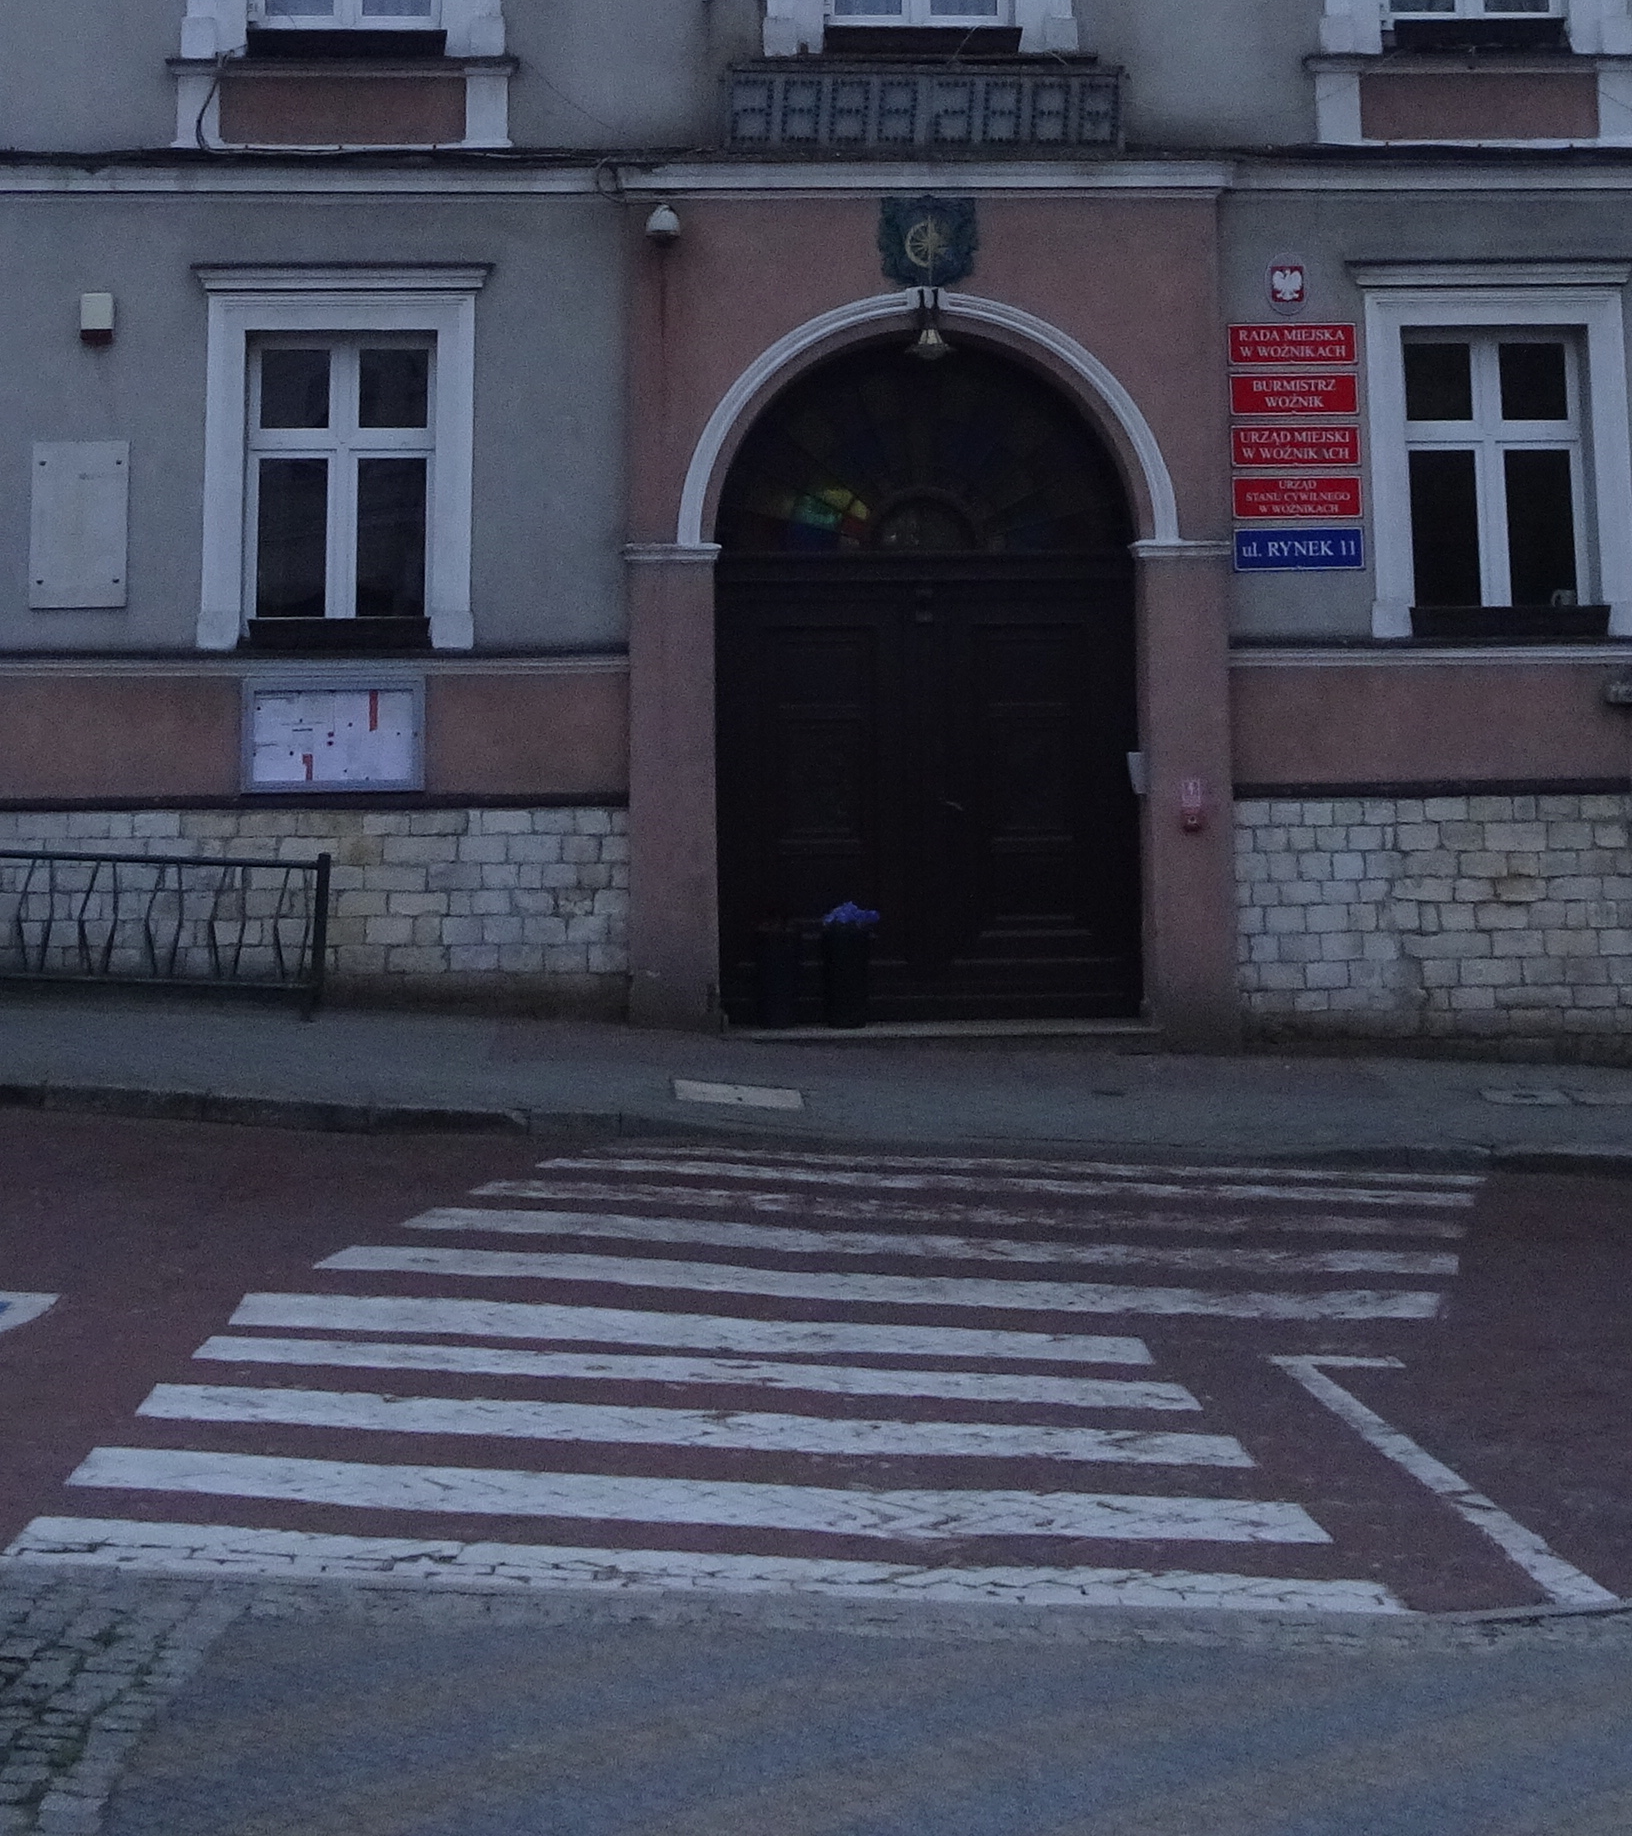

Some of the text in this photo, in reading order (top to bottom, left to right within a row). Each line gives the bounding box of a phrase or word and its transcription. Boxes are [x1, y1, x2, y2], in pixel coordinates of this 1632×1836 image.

[1239, 329, 1345, 341] RADA MIEJSKA
[1240, 346, 1253, 357] W
[1253, 379, 1336, 392] BURMISTRZ
[1240, 431, 1349, 445] URZĄD MIEJSKI
[1242, 447, 1256, 459] W
[1279, 480, 1317, 490] URZĄD
[1284, 491, 1350, 501] CYWILNEGO
[1259, 505, 1268, 513] W
[1242, 540, 1355, 557] ul. RYNEK 11
